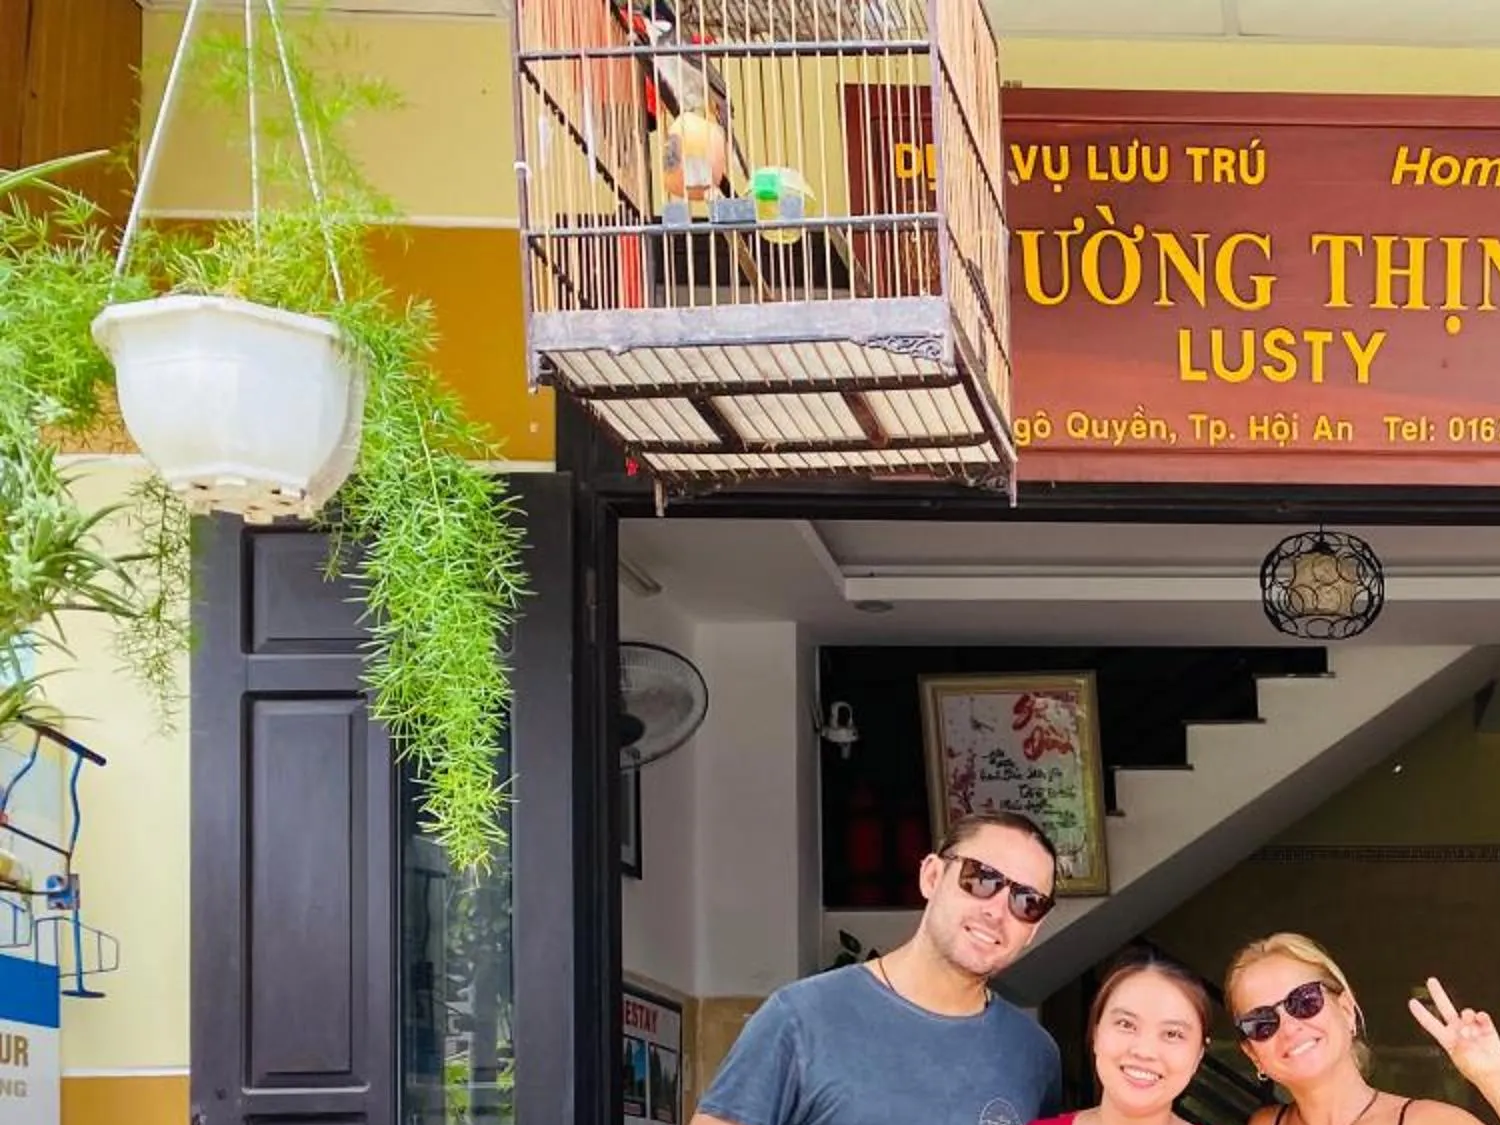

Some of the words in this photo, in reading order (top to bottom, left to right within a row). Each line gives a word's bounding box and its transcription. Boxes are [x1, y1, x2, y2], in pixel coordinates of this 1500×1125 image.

[1010, 143, 1071, 193] VỤ
[1087, 138, 1169, 183] LƯU
[1185, 137, 1267, 186] TRÚ
[1014, 204, 1278, 312] ƯỜNG
[1178, 326, 1387, 385] LUSTY
[1012, 410, 1052, 446] gô
[1066, 404, 1178, 446] Quyền,
[1188, 413, 1237, 445] Tp.
[1249, 412, 1299, 447] Hội
[1312, 414, 1354, 441] An
[1384, 415, 1435, 442] Tel:
[625, 1000, 658, 1035] ESTAY
[0, 1033, 29, 1067] UR
[0, 1078, 28, 1098] NG
